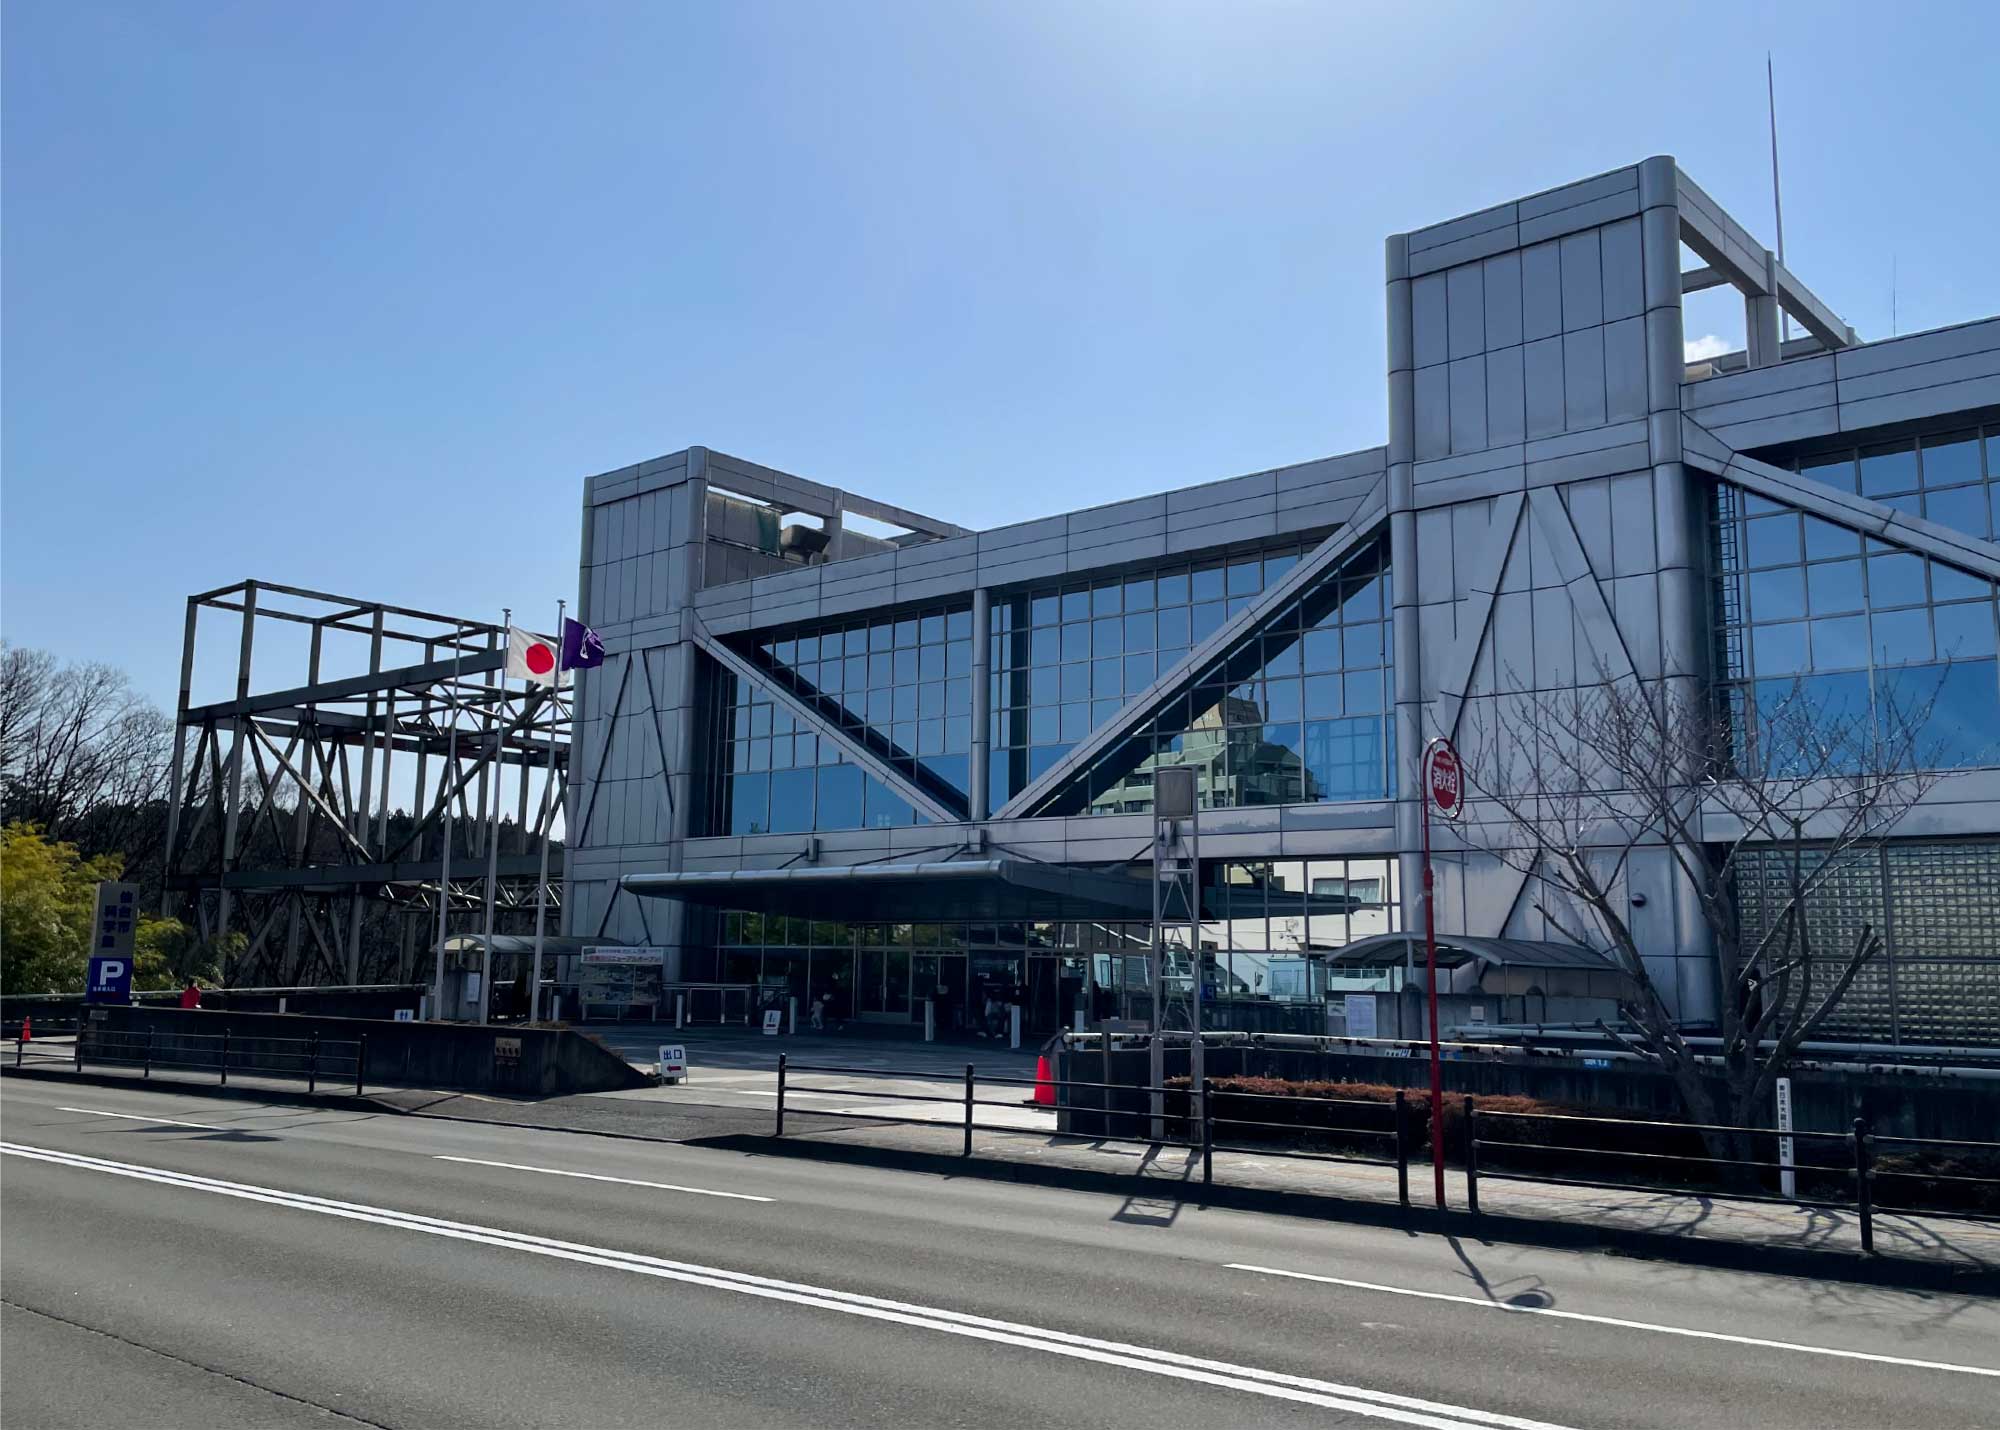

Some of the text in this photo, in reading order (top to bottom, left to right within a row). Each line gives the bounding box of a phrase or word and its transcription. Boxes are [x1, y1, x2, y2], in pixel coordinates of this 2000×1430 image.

[1433, 766, 1456, 794] 消火栓
[118, 891, 133, 934] 仙台市
[100, 960, 125, 985] P
[664, 1049, 682, 1060] 出口
[1779, 1085, 1788, 1158] 東日本大震災
